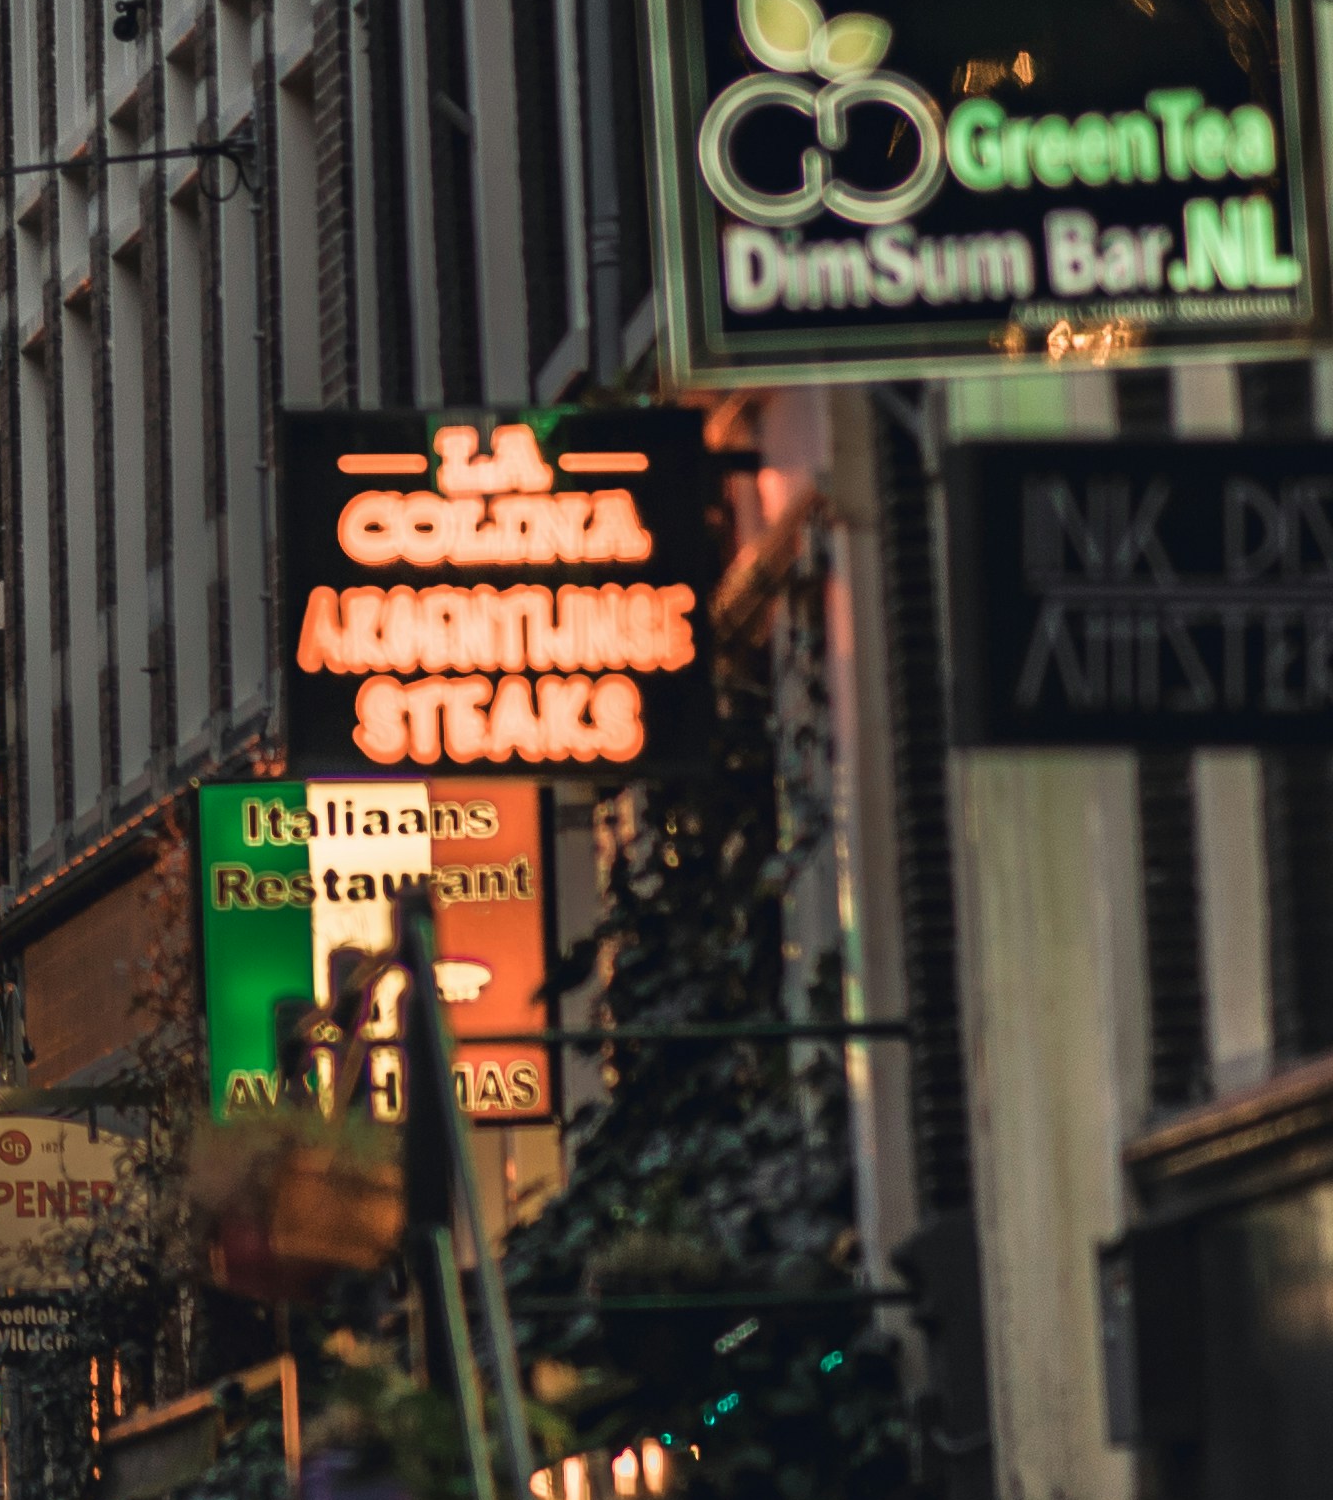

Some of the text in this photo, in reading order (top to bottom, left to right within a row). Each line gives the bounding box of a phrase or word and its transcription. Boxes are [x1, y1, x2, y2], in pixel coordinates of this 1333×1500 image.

[945, 89, 1276, 190] GreenTea
[724, 225, 1031, 313] DimSum
[433, 424, 554, 494] LA
[352, 674, 644, 764] STEAKS
[244, 797, 499, 847] Italiaans
